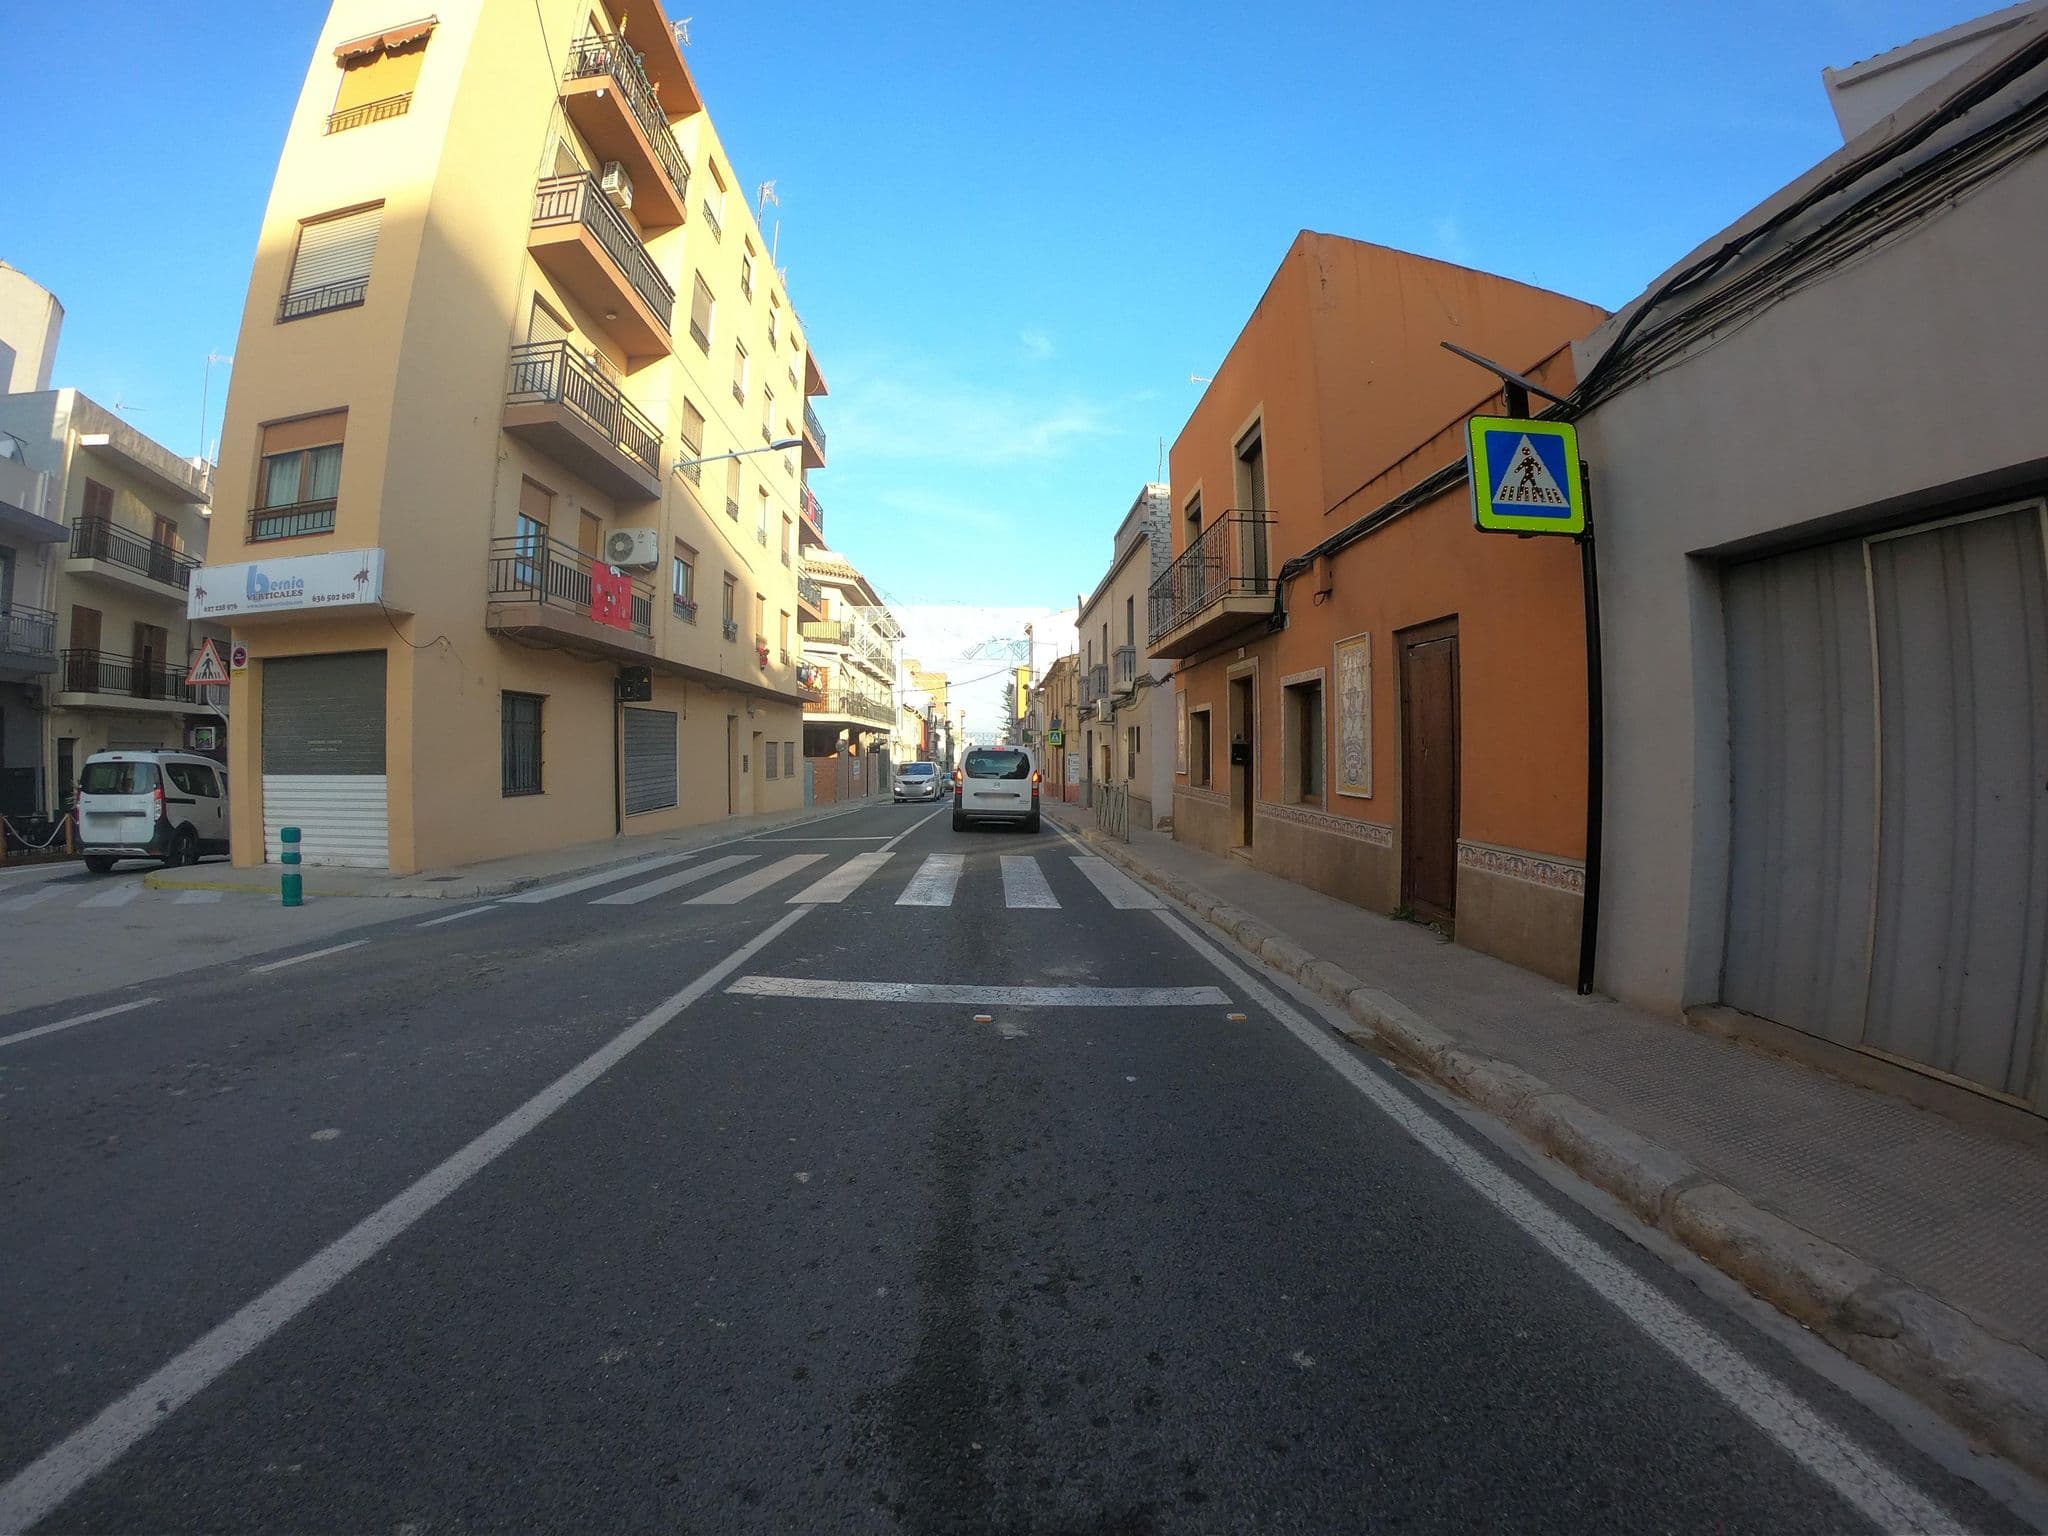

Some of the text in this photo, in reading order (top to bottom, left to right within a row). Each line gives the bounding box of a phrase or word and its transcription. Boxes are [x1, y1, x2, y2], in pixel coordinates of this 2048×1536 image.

[246, 564, 304, 594] bernia
[246, 589, 304, 601] VERTICALES
[312, 594, 325, 603] 636
[341, 592, 355, 600] 608
